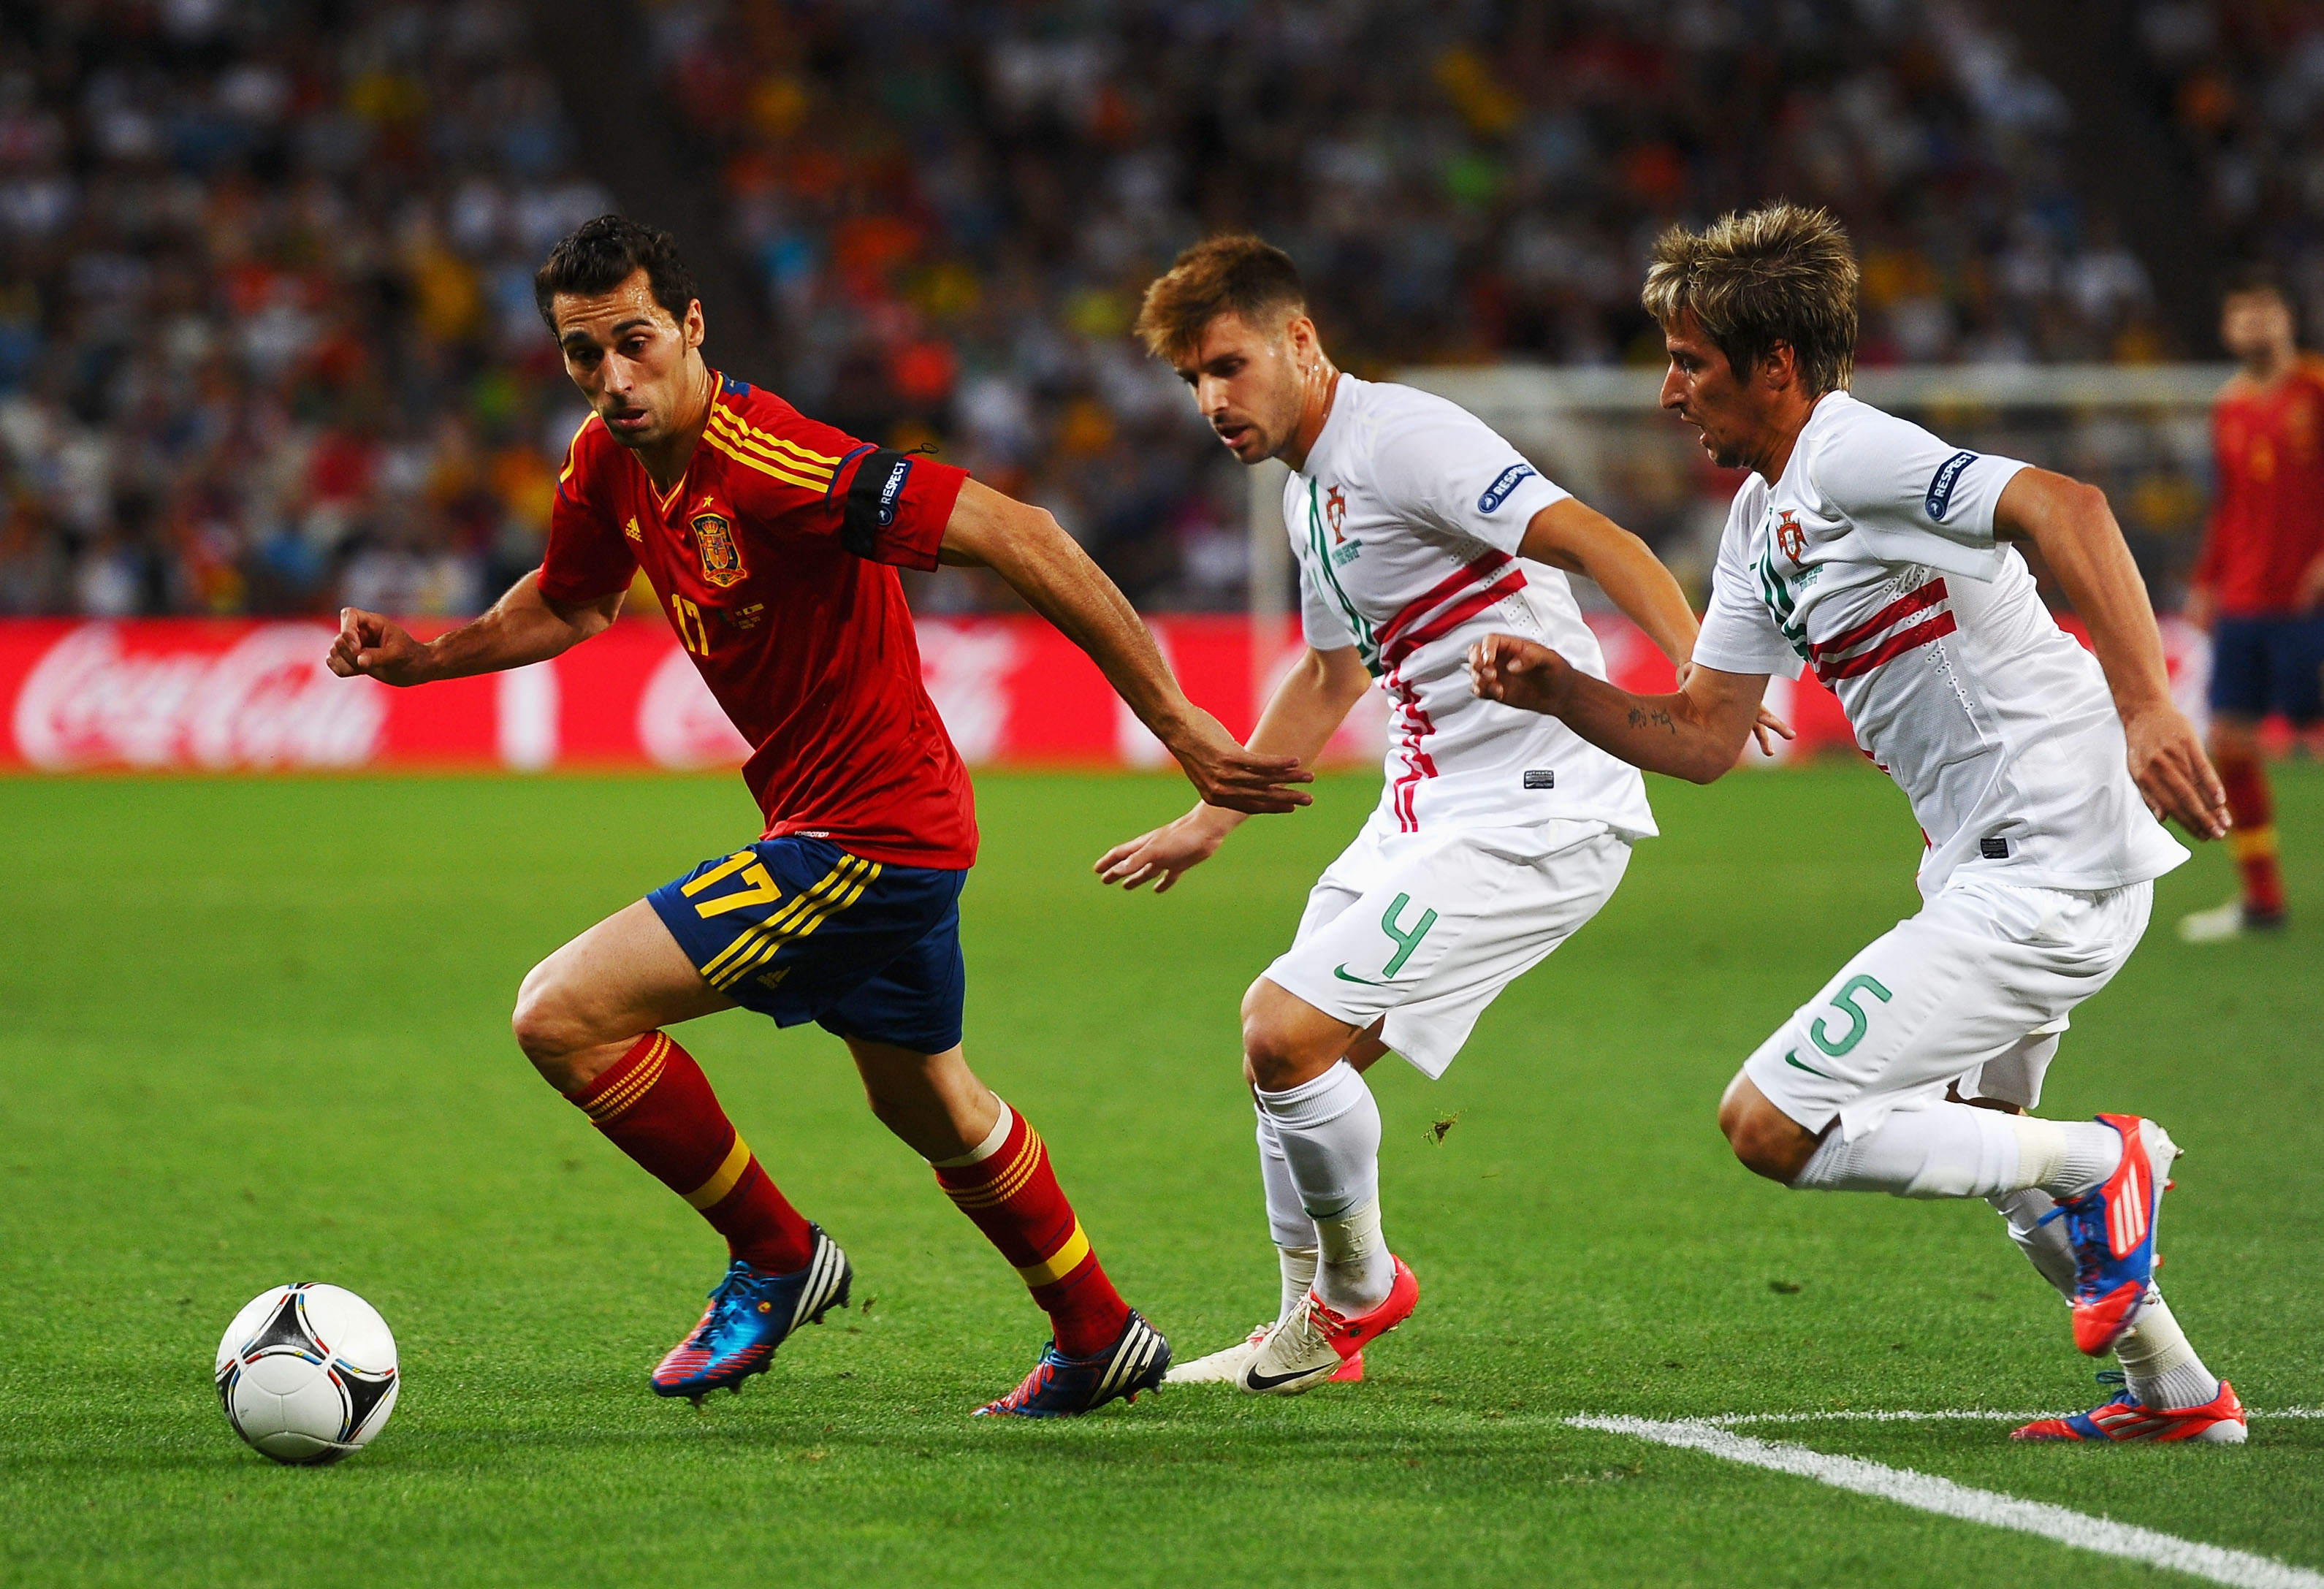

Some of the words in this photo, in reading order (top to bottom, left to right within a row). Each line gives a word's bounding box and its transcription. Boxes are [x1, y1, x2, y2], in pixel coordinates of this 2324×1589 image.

[880, 462, 906, 504] RESPECT
[1934, 454, 1972, 497] RESPECT
[671, 594, 709, 656] 17
[681, 850, 782, 919] 17
[1382, 892, 1438, 979] 4
[1810, 975, 1892, 1056] 5
